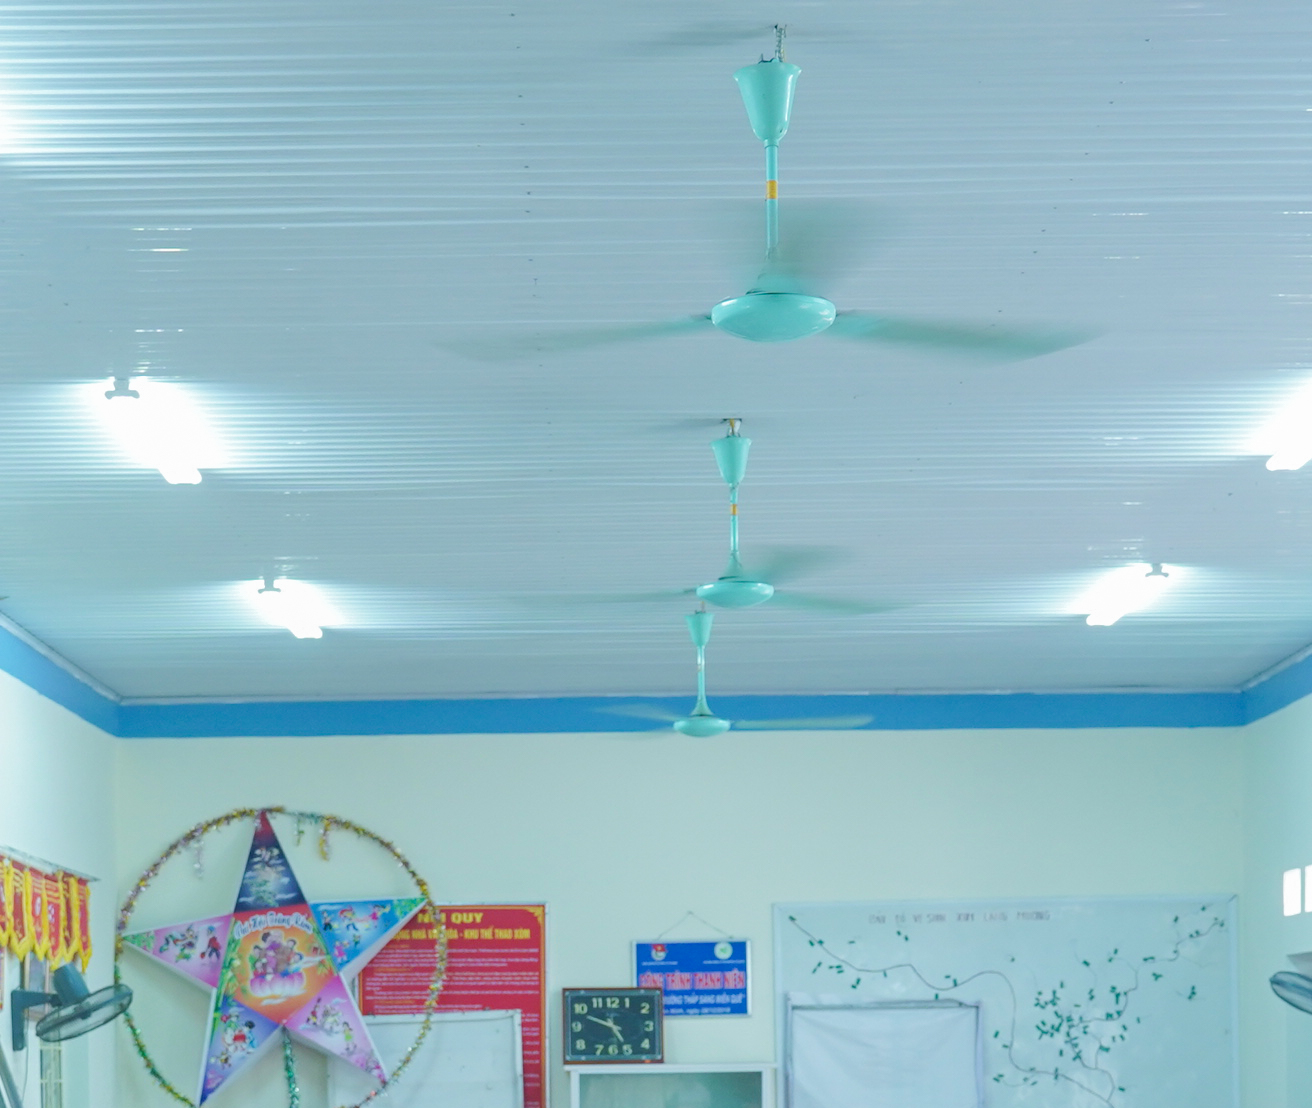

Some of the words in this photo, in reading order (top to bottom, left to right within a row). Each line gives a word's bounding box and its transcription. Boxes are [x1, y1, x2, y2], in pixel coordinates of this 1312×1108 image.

[451, 912, 483, 924] QUY
[495, 928, 513, 940] THAO
[574, 1003, 588, 1014] 10
[592, 997, 603, 1008] 11
[606, 997, 620, 1008] 12
[624, 997, 630, 1009] 1
[640, 1002, 650, 1014] 2
[571, 1021, 582, 1032] 9
[644, 1020, 654, 1032] 3
[575, 1038, 586, 1051] 8
[595, 1044, 604, 1056] 7
[608, 1044, 618, 1055] 6
[622, 1044, 633, 1055] 5
[640, 1038, 650, 1050] 4
